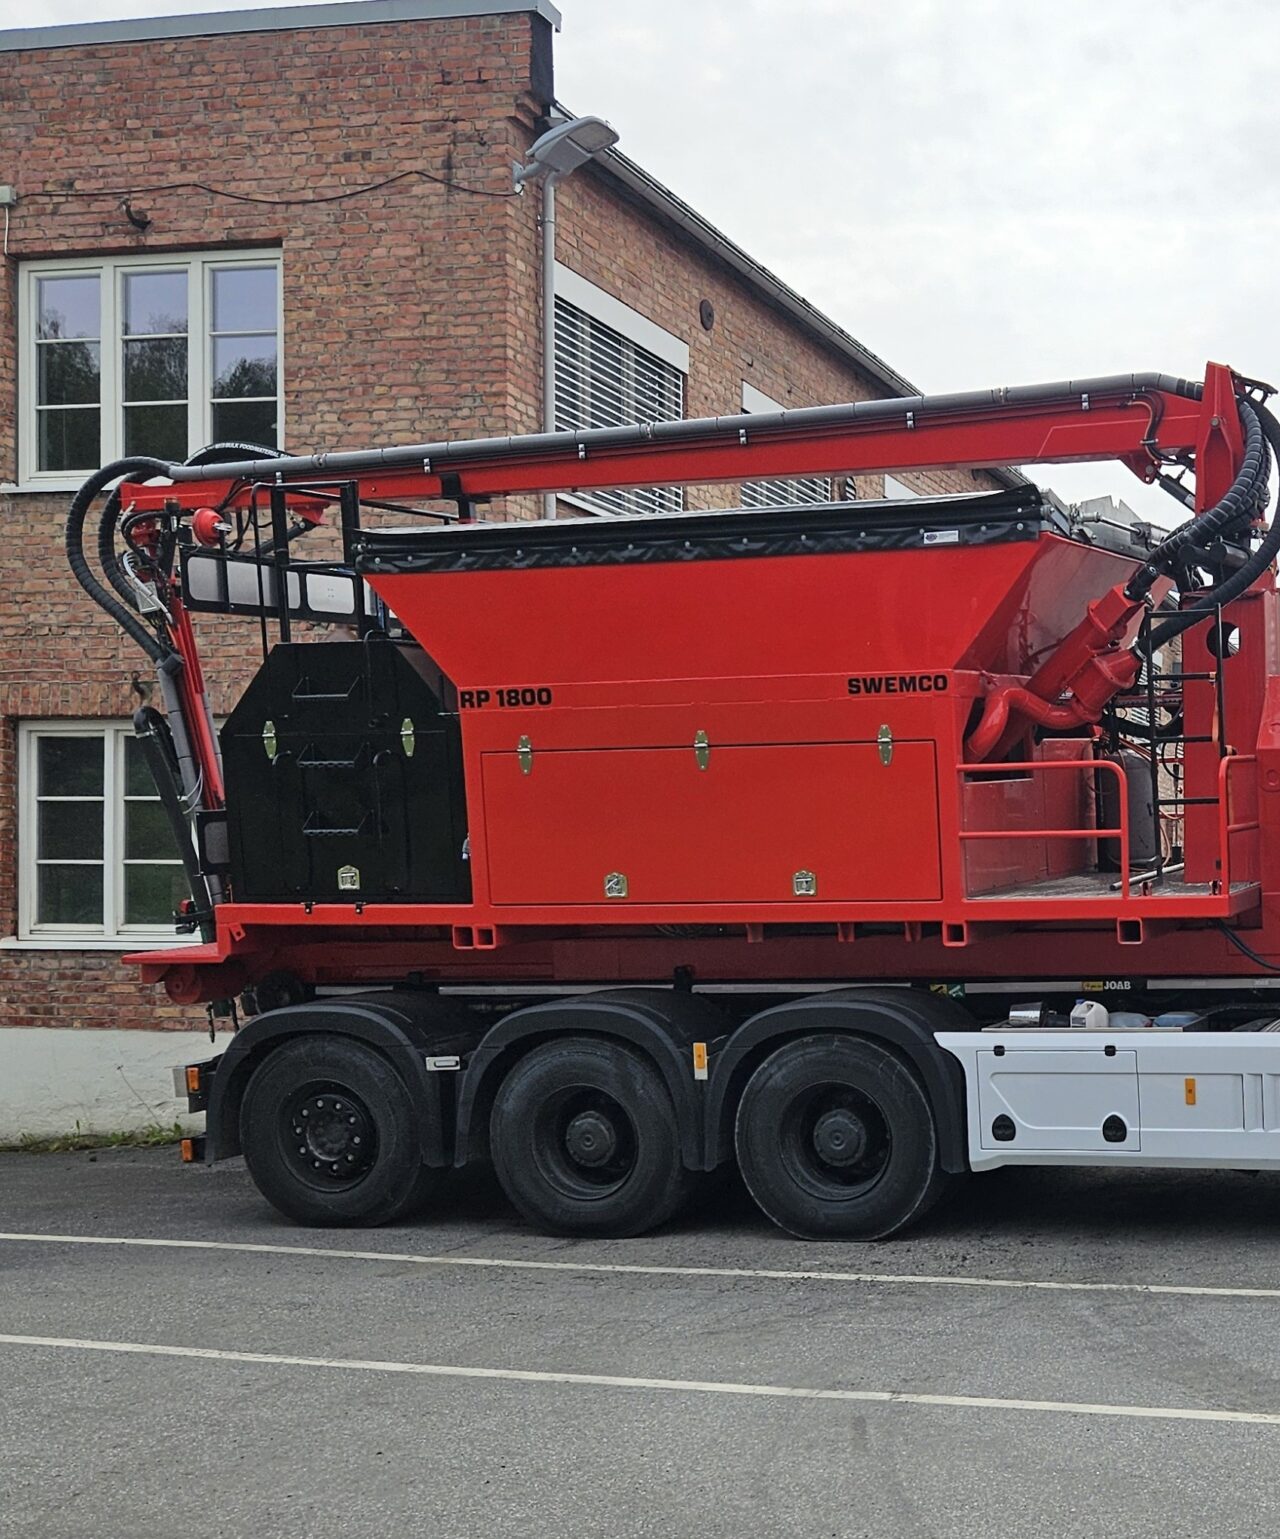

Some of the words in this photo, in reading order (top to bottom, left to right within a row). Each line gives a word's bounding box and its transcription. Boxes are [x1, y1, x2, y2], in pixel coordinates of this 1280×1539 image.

[847, 674, 948, 695] SWEMCO
[460, 689, 490, 709] RP
[496, 688, 552, 707] 1800
[1103, 980, 1131, 990] JOAB
